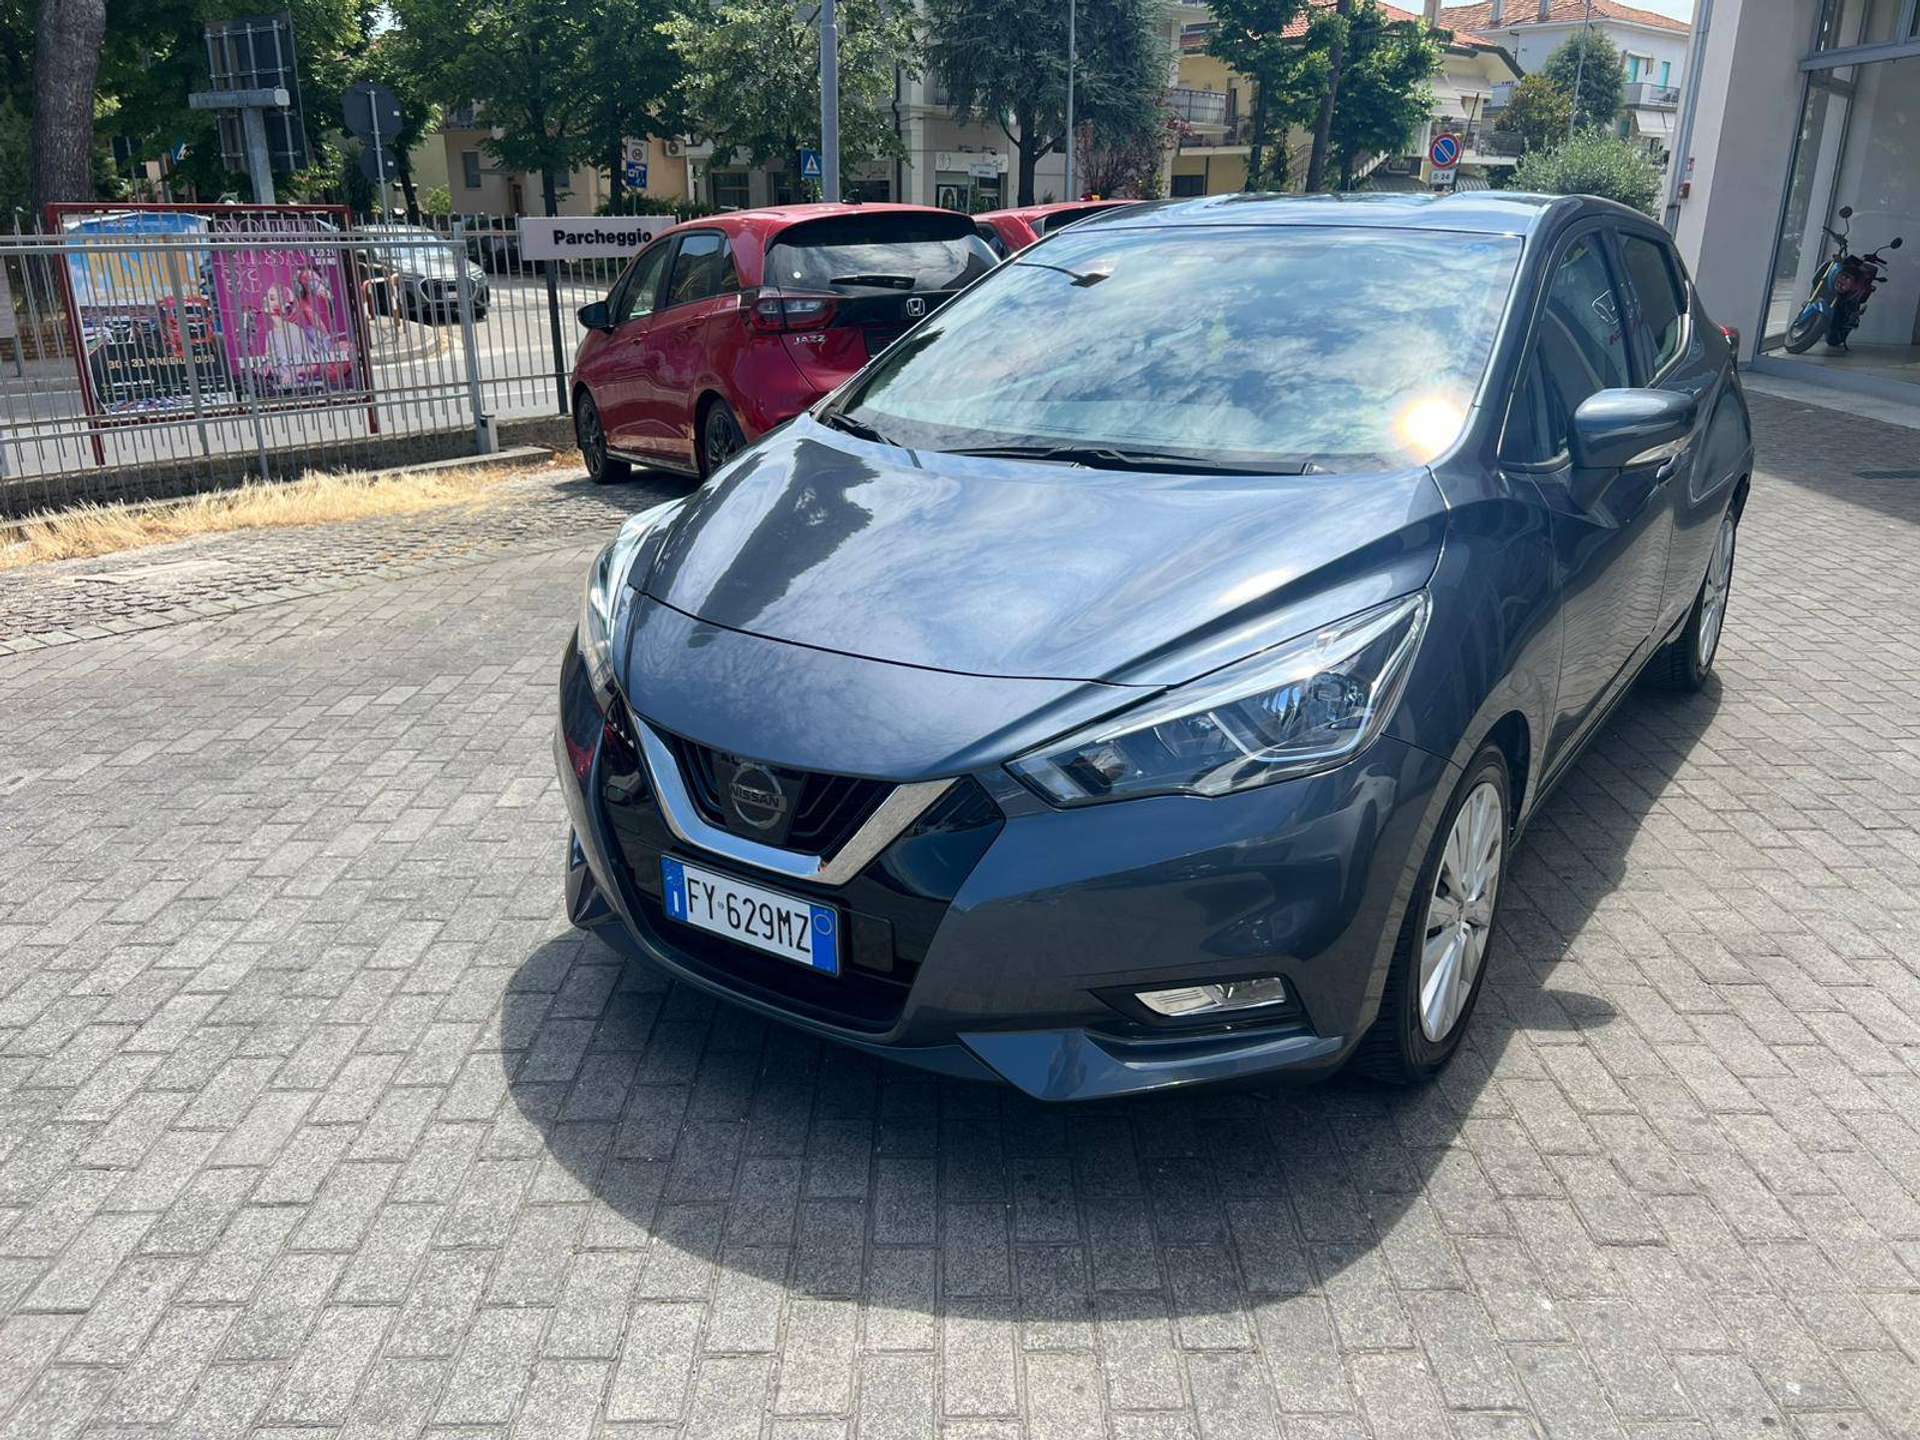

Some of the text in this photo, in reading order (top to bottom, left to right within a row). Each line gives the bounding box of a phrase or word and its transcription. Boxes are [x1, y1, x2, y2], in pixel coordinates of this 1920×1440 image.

[553, 228, 652, 246] Parcheggio
[793, 334, 826, 346] JAZZ
[131, 358, 146, 368] 31
[729, 783, 780, 809] NISSAN
[687, 878, 715, 920] FY
[726, 893, 811, 953] 629MZ
